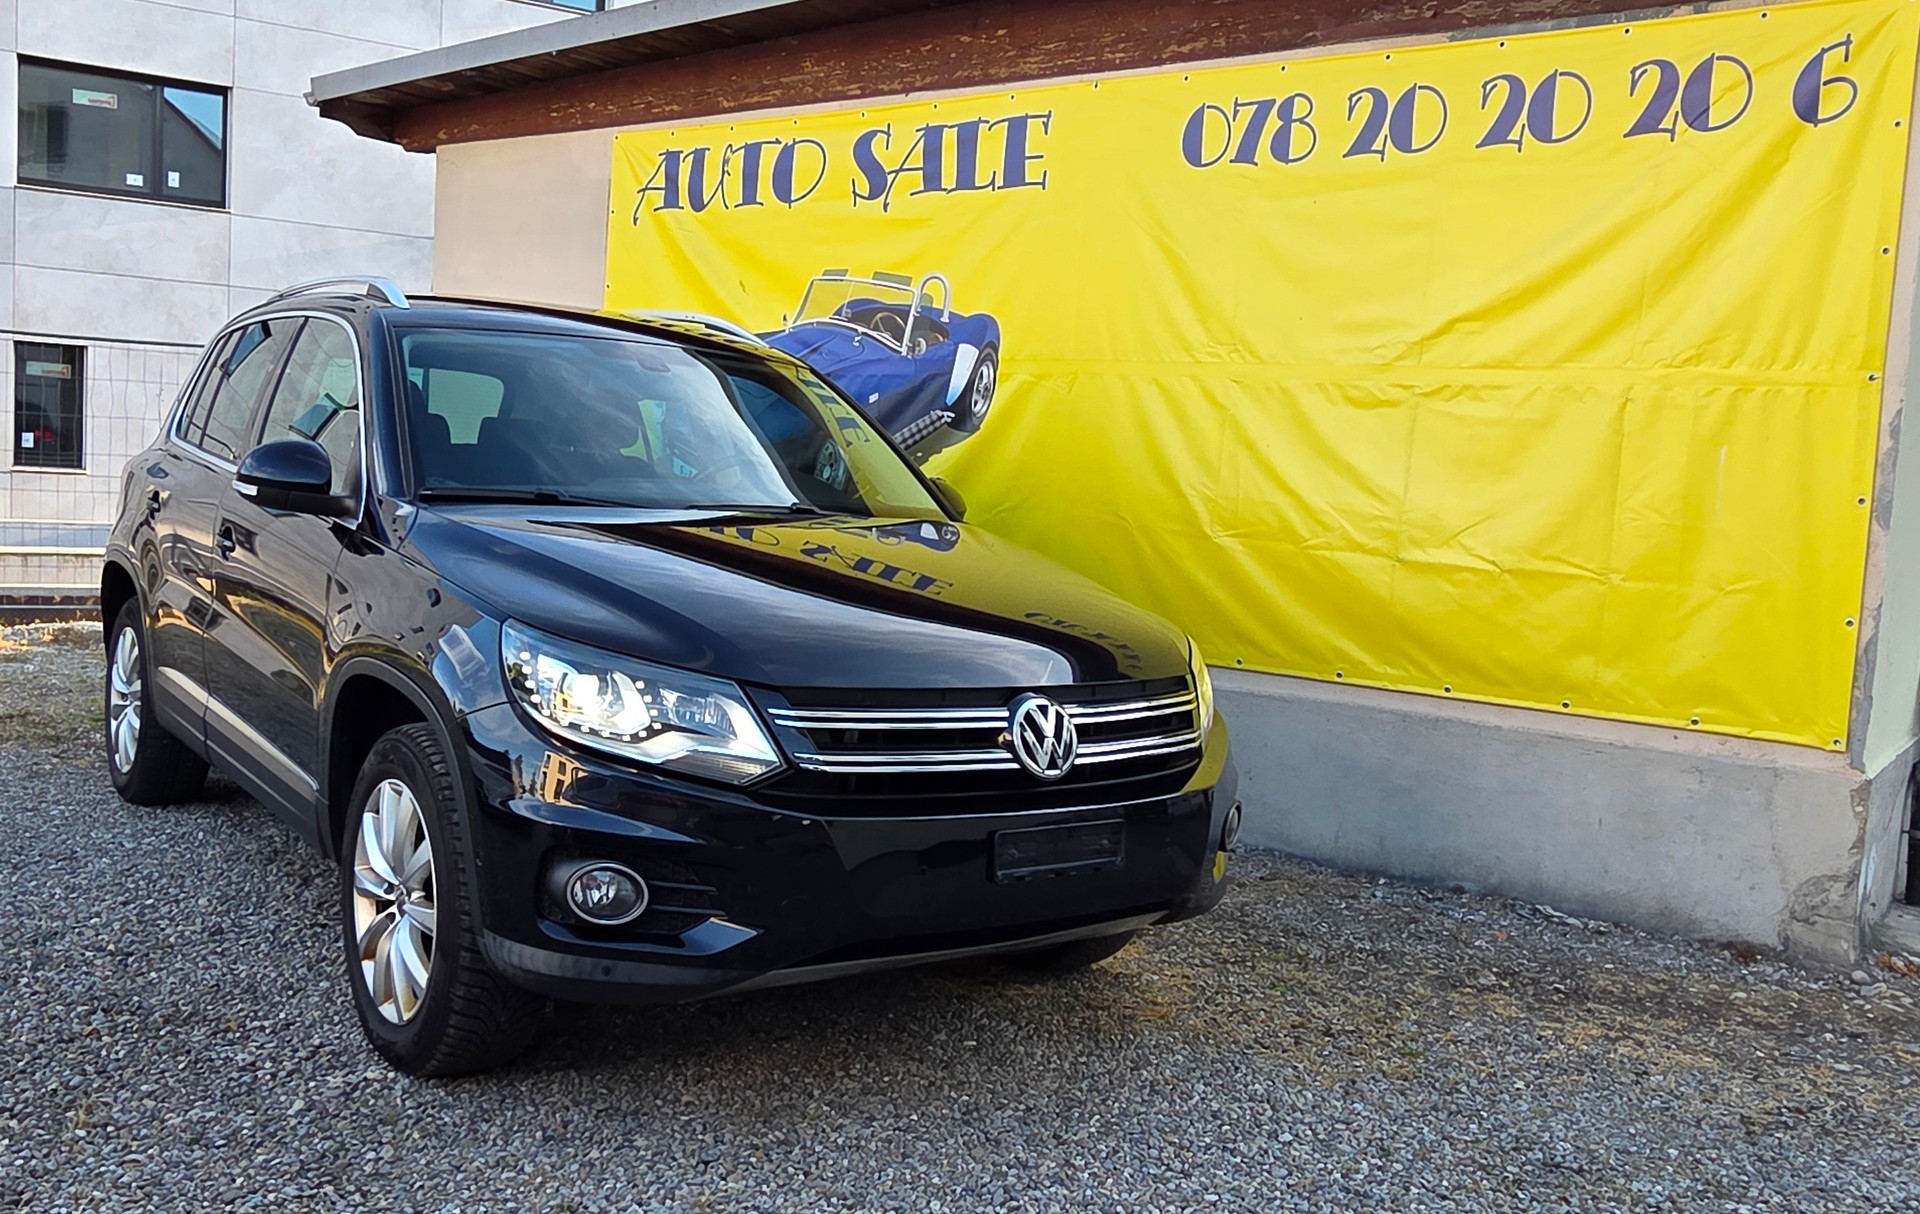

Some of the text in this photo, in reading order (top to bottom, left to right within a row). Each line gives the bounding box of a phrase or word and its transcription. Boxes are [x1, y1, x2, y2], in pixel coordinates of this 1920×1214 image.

[1182, 33, 1859, 168] 078 20 20 20 6
[632, 110, 1052, 226] AUTO SALE
[1015, 699, 1077, 777] VW
